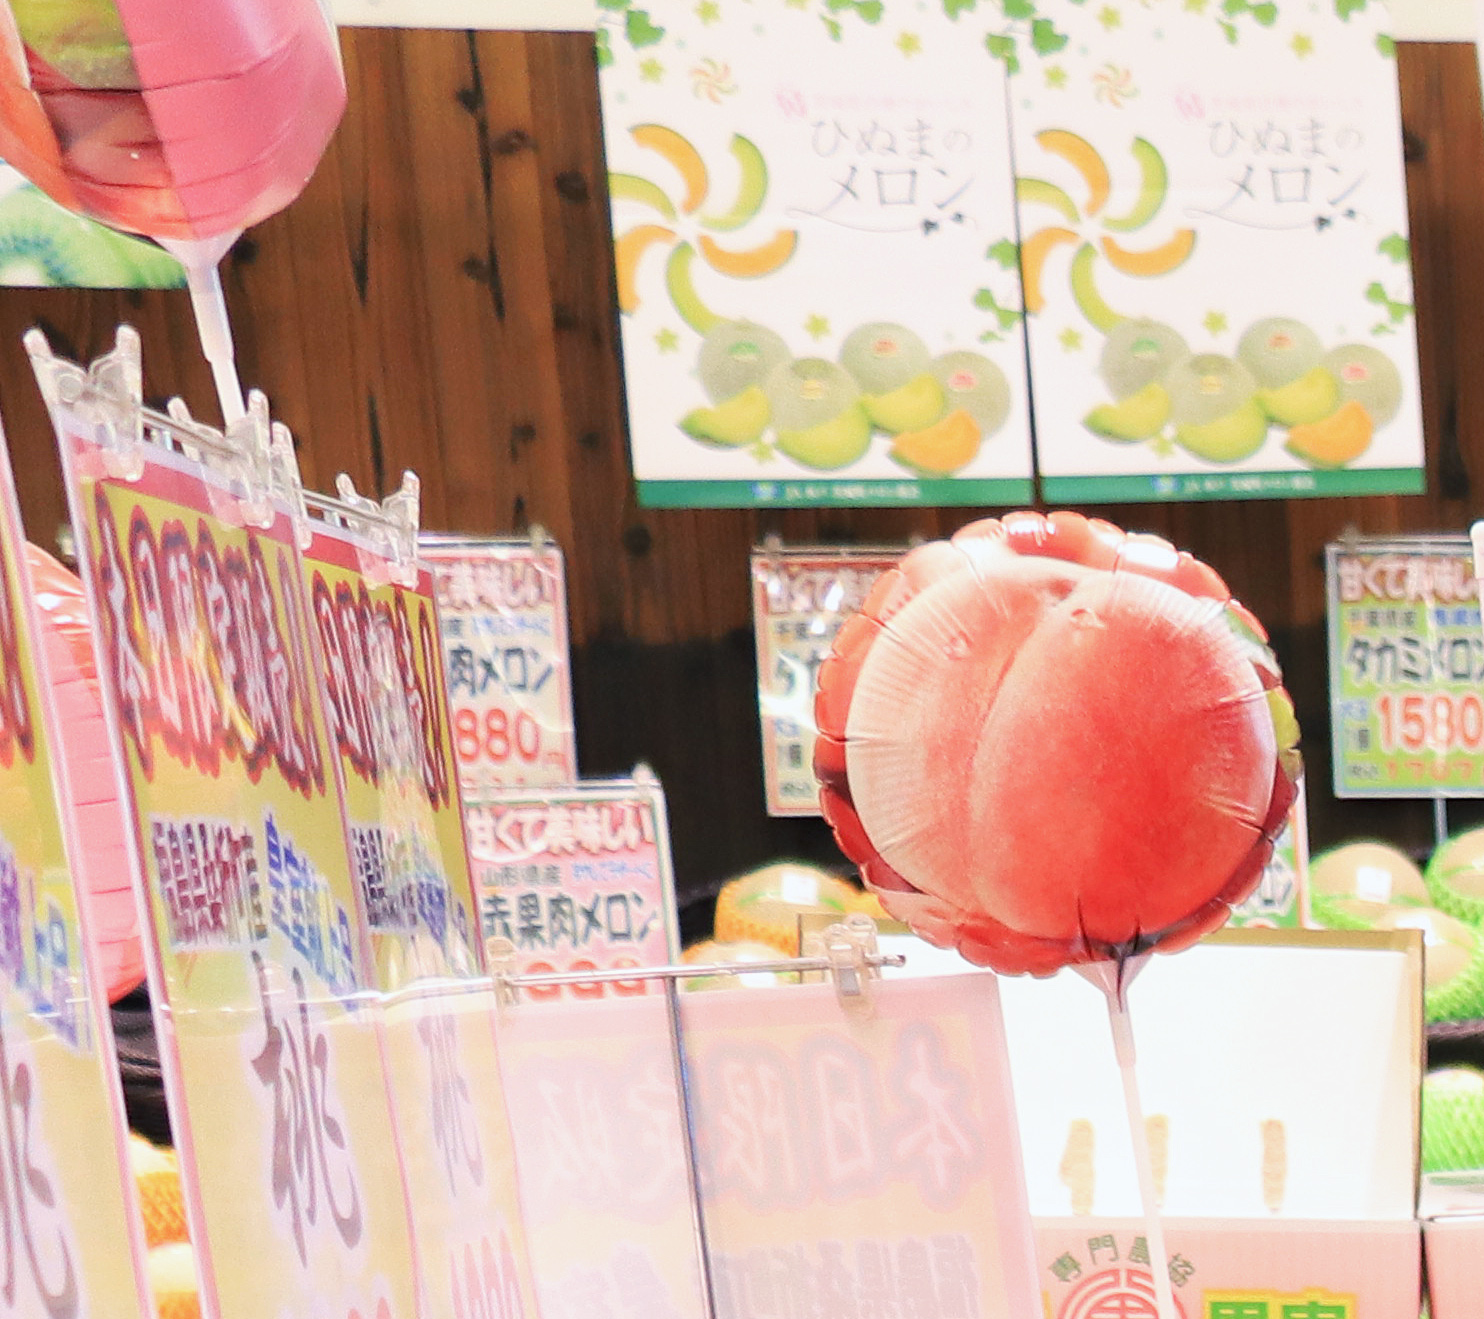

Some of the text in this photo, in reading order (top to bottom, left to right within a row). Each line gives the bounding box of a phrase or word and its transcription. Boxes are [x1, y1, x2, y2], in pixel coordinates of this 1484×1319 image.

[816, 165, 976, 214] メロン
[1217, 163, 1370, 212] メロン
[1378, 696, 1484, 749] 1580
[466, 803, 656, 858] 甘くて美味しい
[251, 950, 363, 1270] 桃
